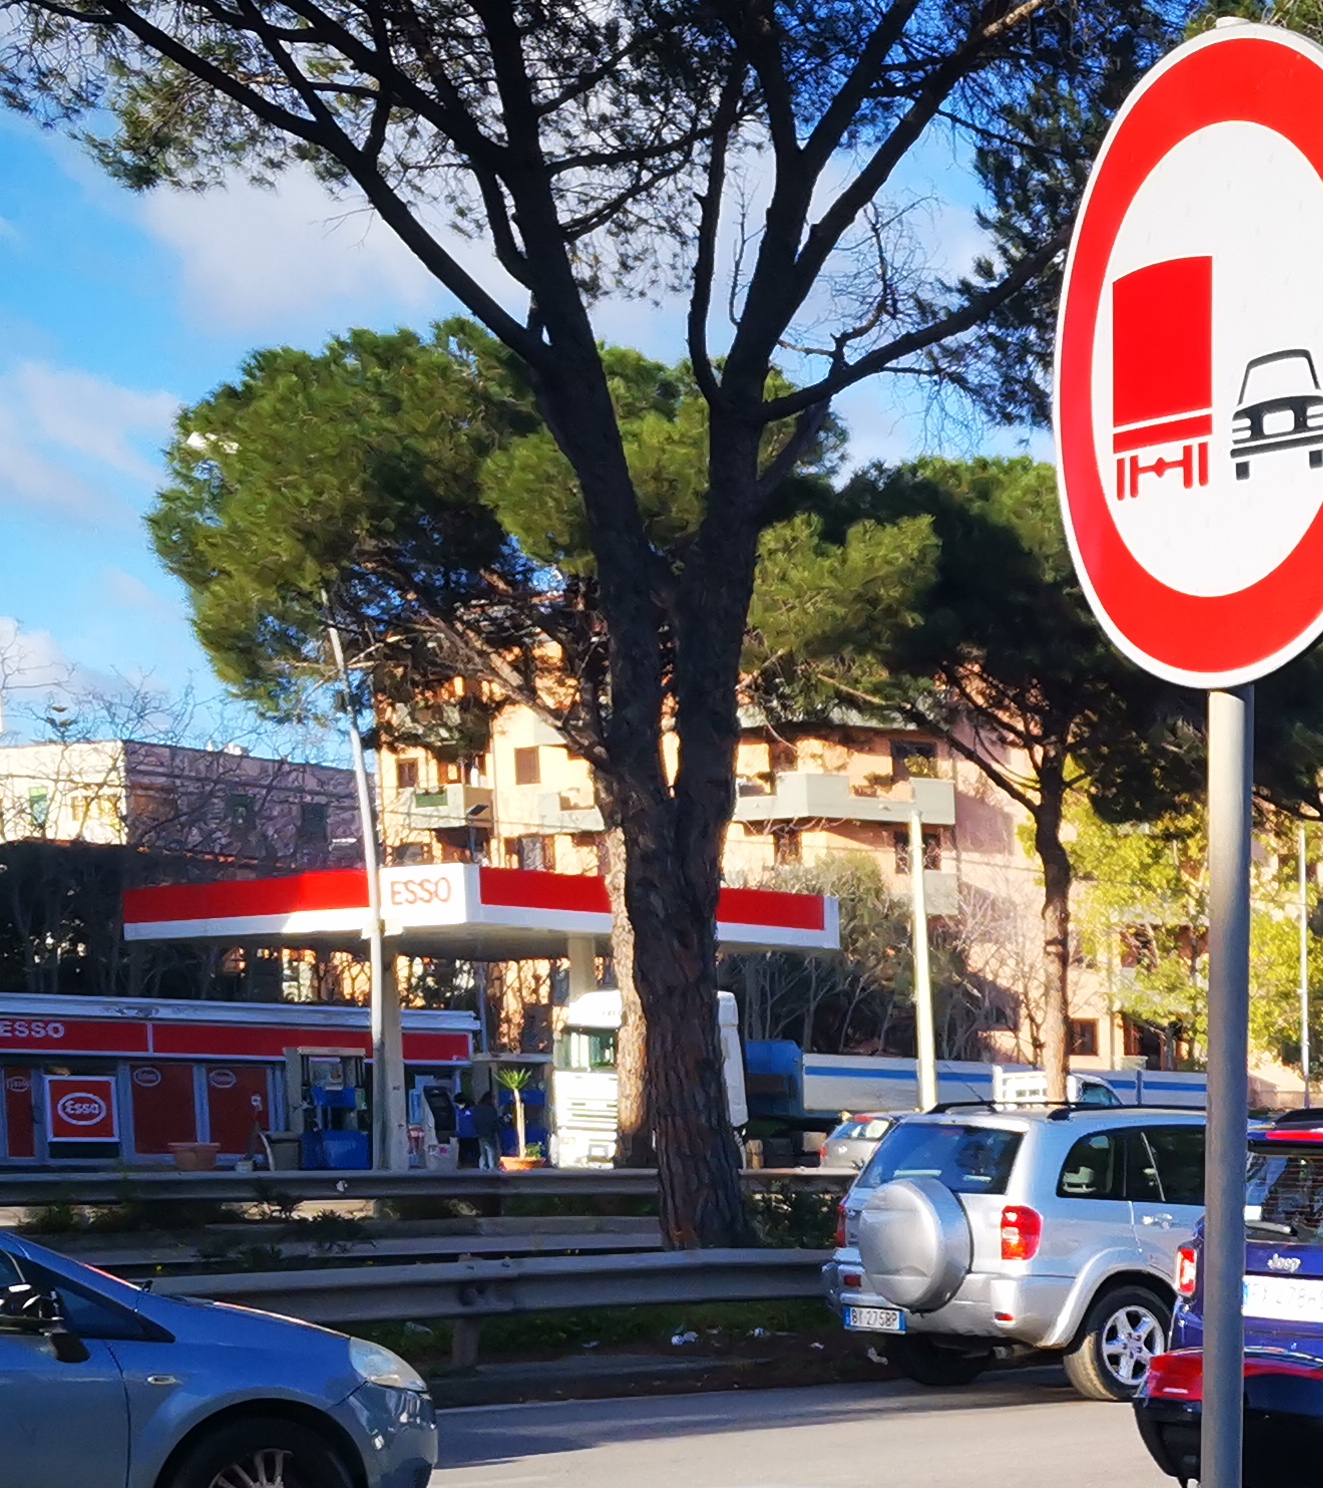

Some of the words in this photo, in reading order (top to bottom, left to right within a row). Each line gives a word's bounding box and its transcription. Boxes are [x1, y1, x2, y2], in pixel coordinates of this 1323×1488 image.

[390, 877, 452, 906] ESSO
[0, 1020, 66, 1039] ESSO
[64, 1099, 100, 1116] Esso
[1267, 1253, 1301, 1273] Jeep
